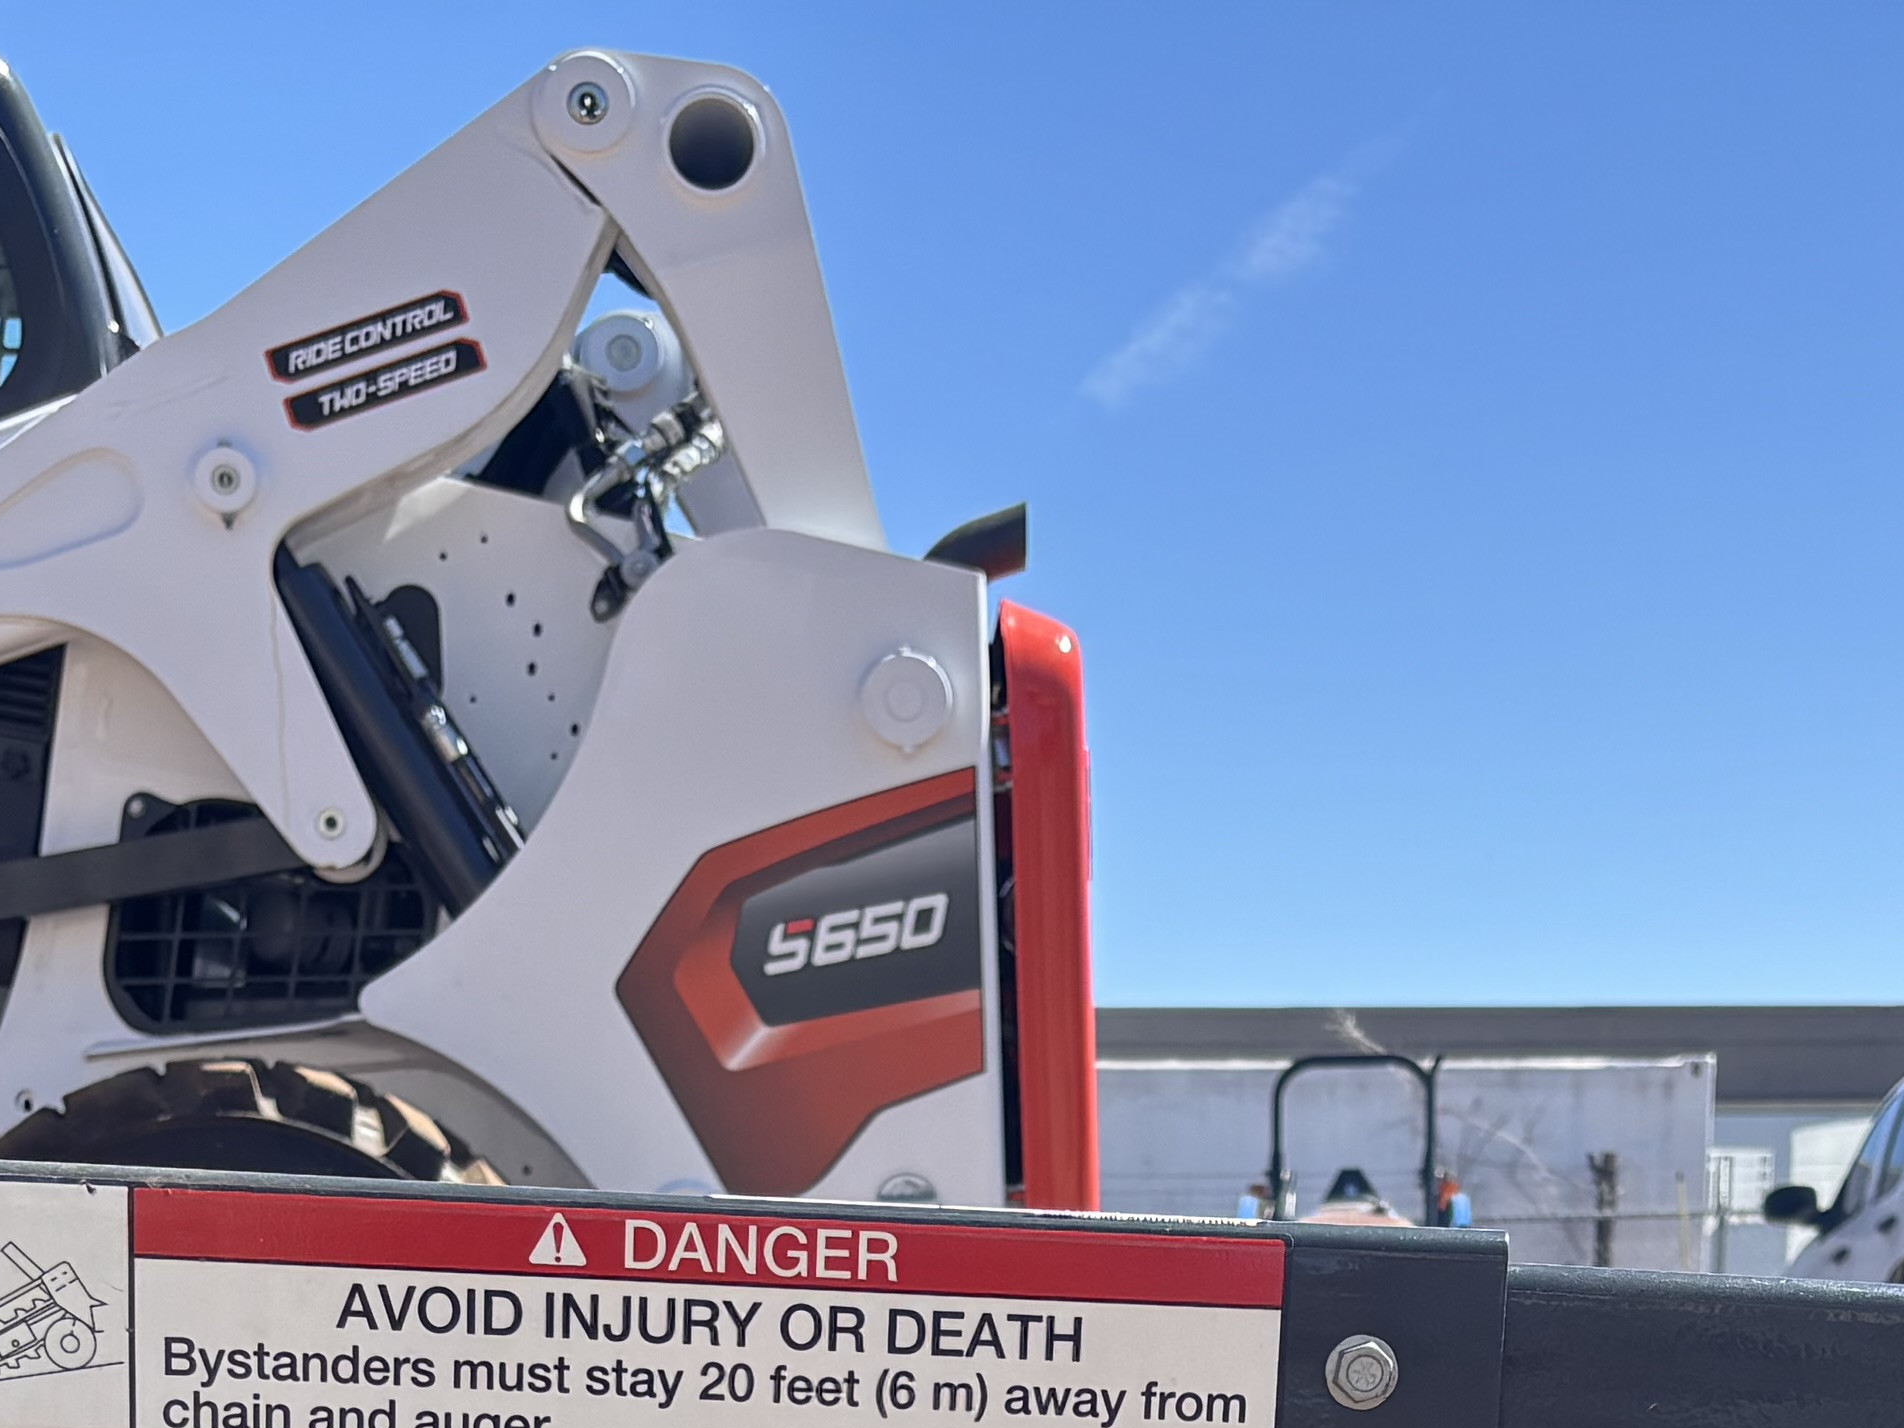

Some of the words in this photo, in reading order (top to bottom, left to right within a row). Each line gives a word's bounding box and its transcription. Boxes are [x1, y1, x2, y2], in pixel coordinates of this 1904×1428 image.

[287, 339, 343, 375] RIDE
[343, 299, 455, 355] CONTROL
[317, 349, 457, 417] TWO-SPEED
[763, 892, 950, 977] S650
[624, 1218, 899, 1282] DANGER
[335, 1282, 523, 1336] AVOID
[545, 1291, 763, 1348] INJURY
[779, 1302, 866, 1353] OR
[887, 1308, 1083, 1363] DEATH
[164, 1336, 436, 1389] Bystanders
[453, 1356, 571, 1399] must
[585, 1359, 684, 1410] stay
[698, 1361, 755, 1403] 20
[769, 1364, 860, 1408] feet
[875, 1368, 916, 1419] (6
[932, 1372, 988, 1423] m)
[1004, 1384, 1127, 1428] away
[1140, 1380, 1247, 1424] from
